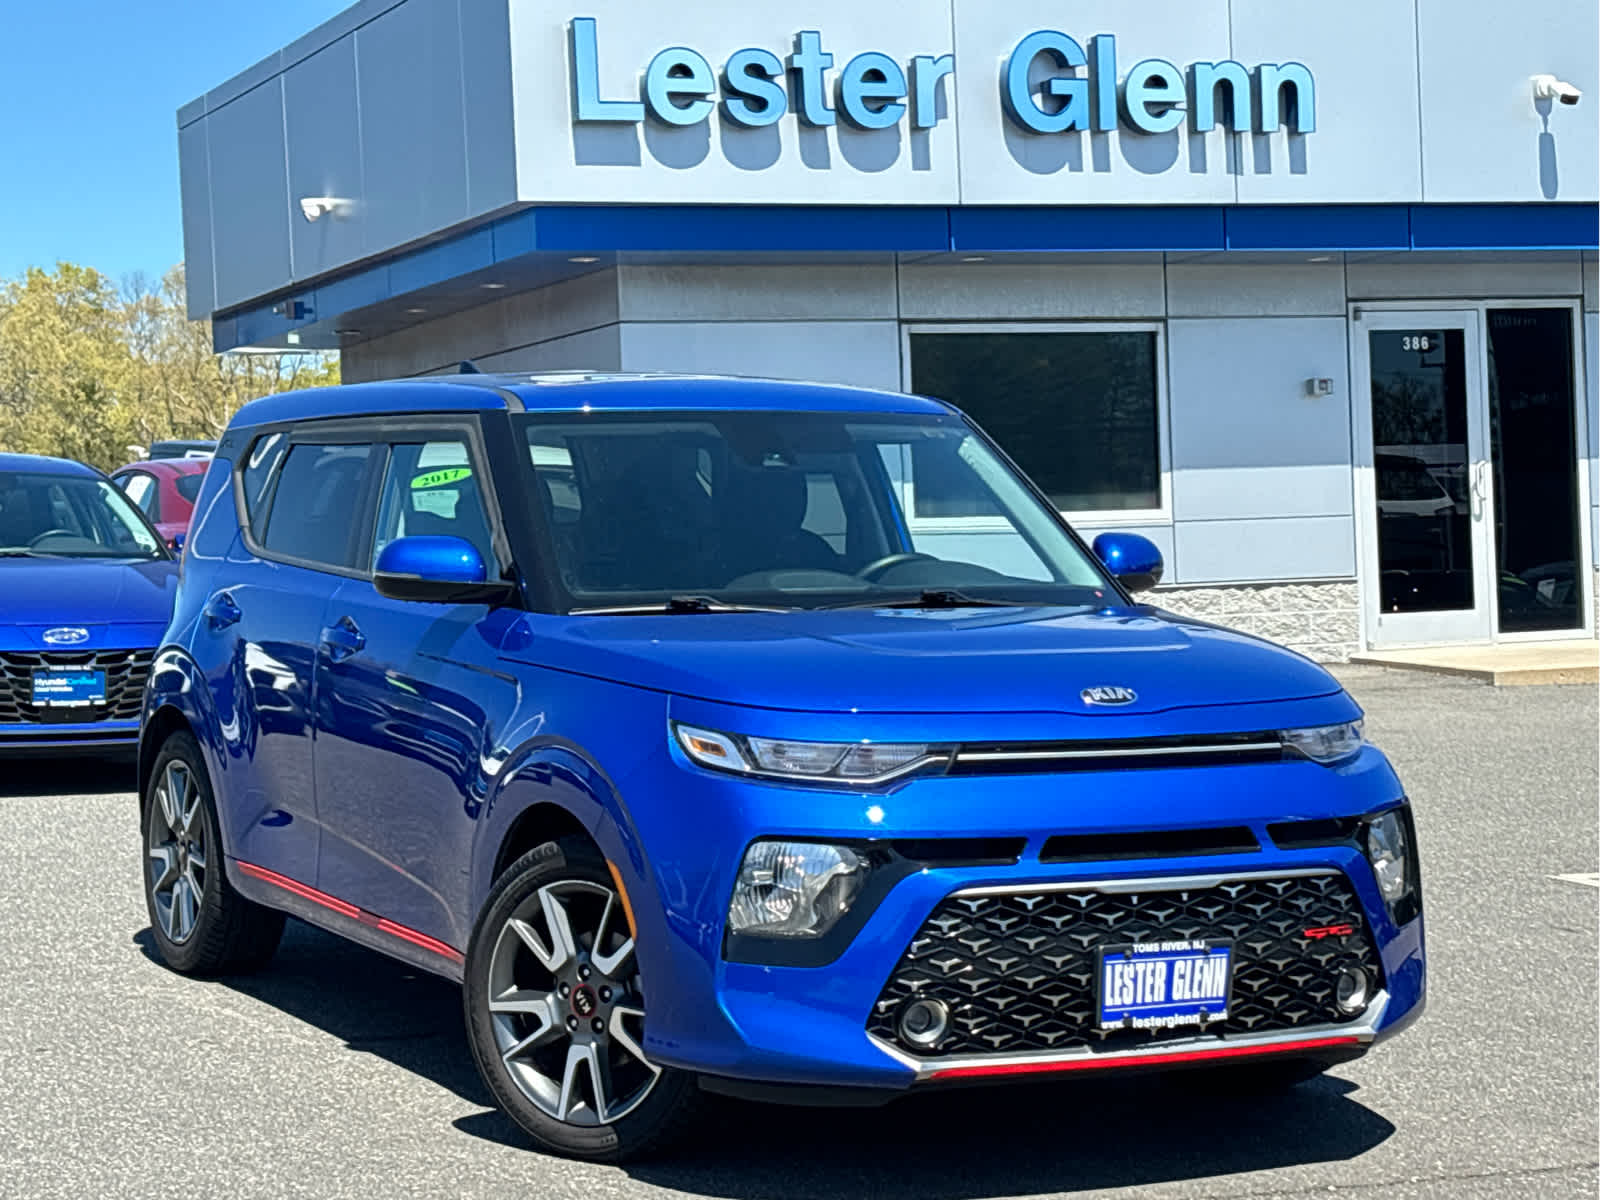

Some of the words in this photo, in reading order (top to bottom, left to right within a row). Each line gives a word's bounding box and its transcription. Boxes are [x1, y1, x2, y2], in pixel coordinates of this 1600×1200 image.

[567, 17, 954, 129] Lester
[1003, 21, 1317, 135] Glenn
[1402, 335, 1430, 351] 386
[422, 469, 460, 487] 2017
[1087, 686, 1133, 701] KIA
[1132, 943, 1160, 954] TOMS
[1104, 960, 1168, 1007] LESTER
[1172, 956, 1228, 1001] GLENN
